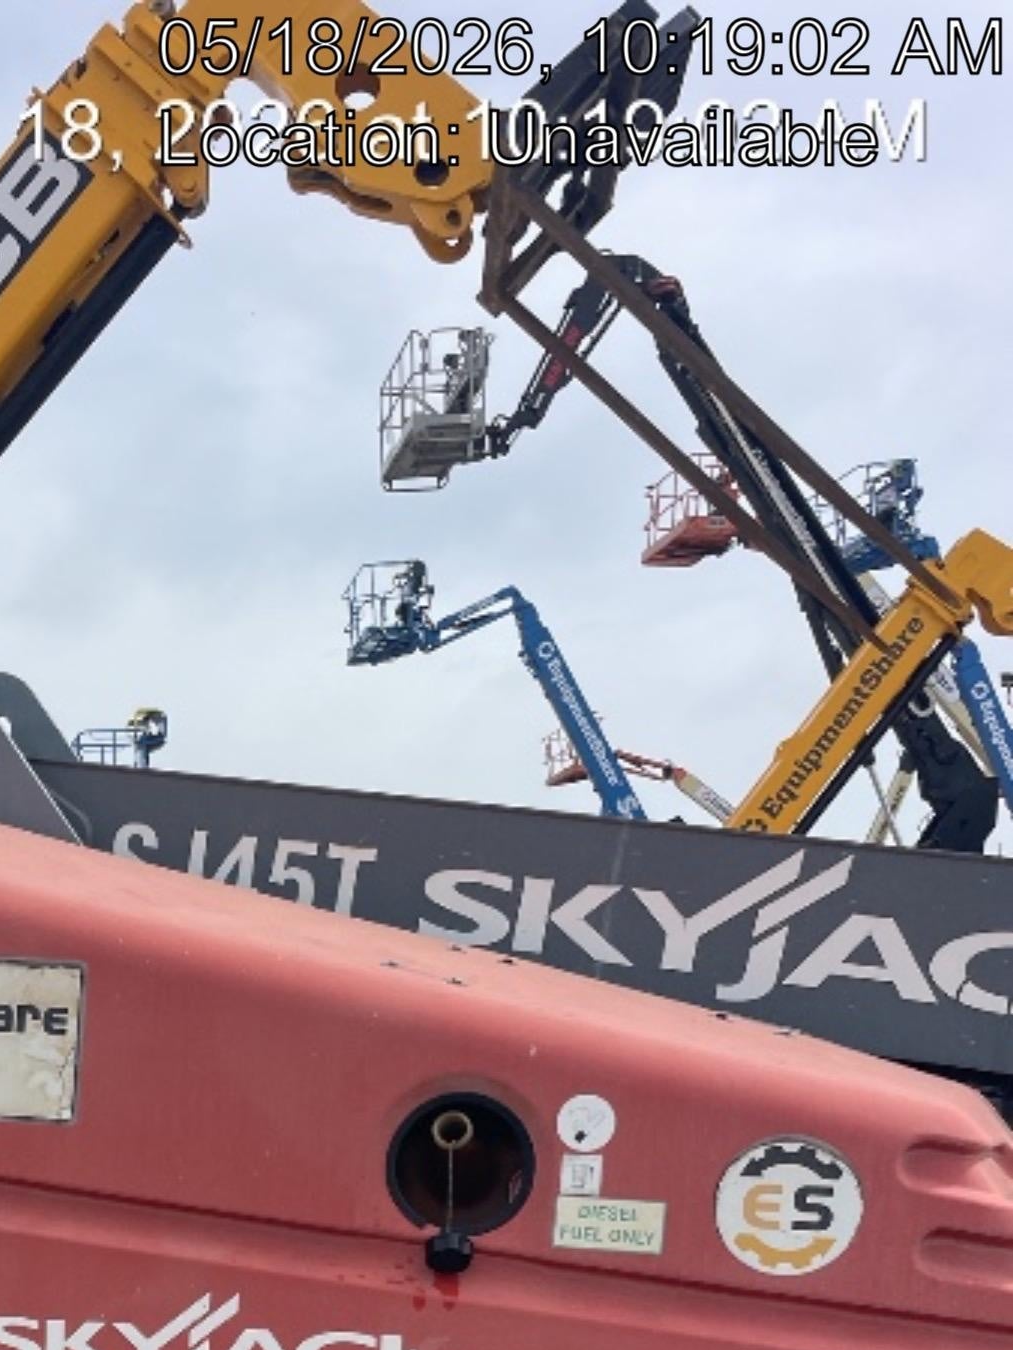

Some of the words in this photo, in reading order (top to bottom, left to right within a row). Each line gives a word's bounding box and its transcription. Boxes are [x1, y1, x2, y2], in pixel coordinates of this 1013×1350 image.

[760, 616, 925, 820] EquipmentShare
[578, 1204, 638, 1223] DIESEL
[742, 1183, 835, 1232] ES
[559, 1224, 603, 1243] FUEL
[608, 1228, 655, 1246] ONLY
